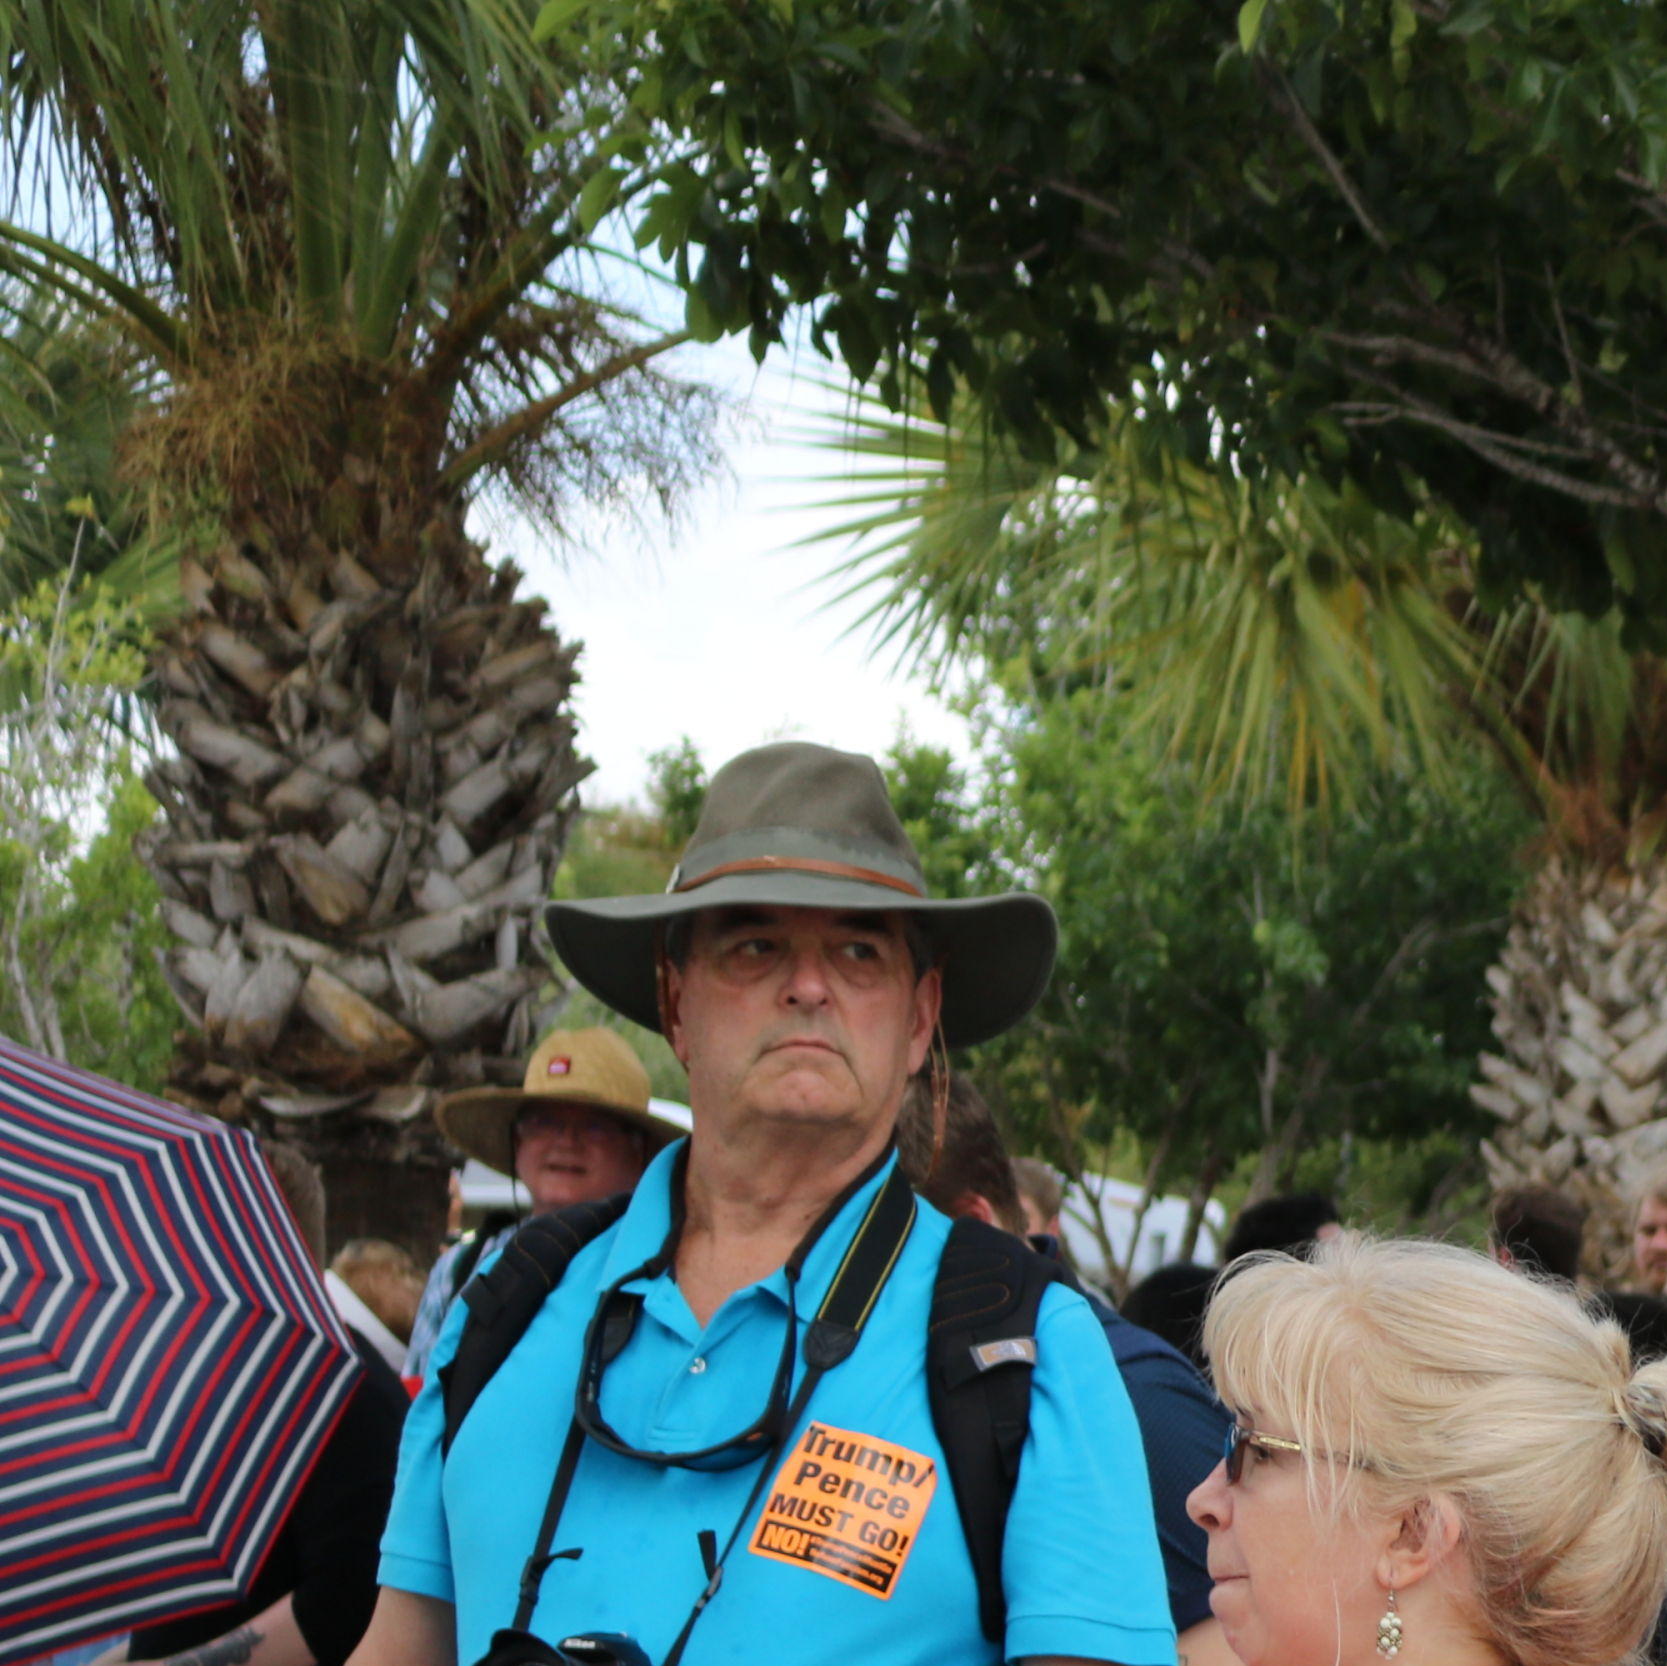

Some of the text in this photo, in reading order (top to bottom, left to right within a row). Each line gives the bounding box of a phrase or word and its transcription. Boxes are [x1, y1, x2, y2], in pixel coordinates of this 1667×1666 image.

[794, 1461, 910, 1519] Pence
[761, 1523, 811, 1556] NO!
[769, 1493, 854, 1532] MUST
[858, 1520, 909, 1557] GO!
